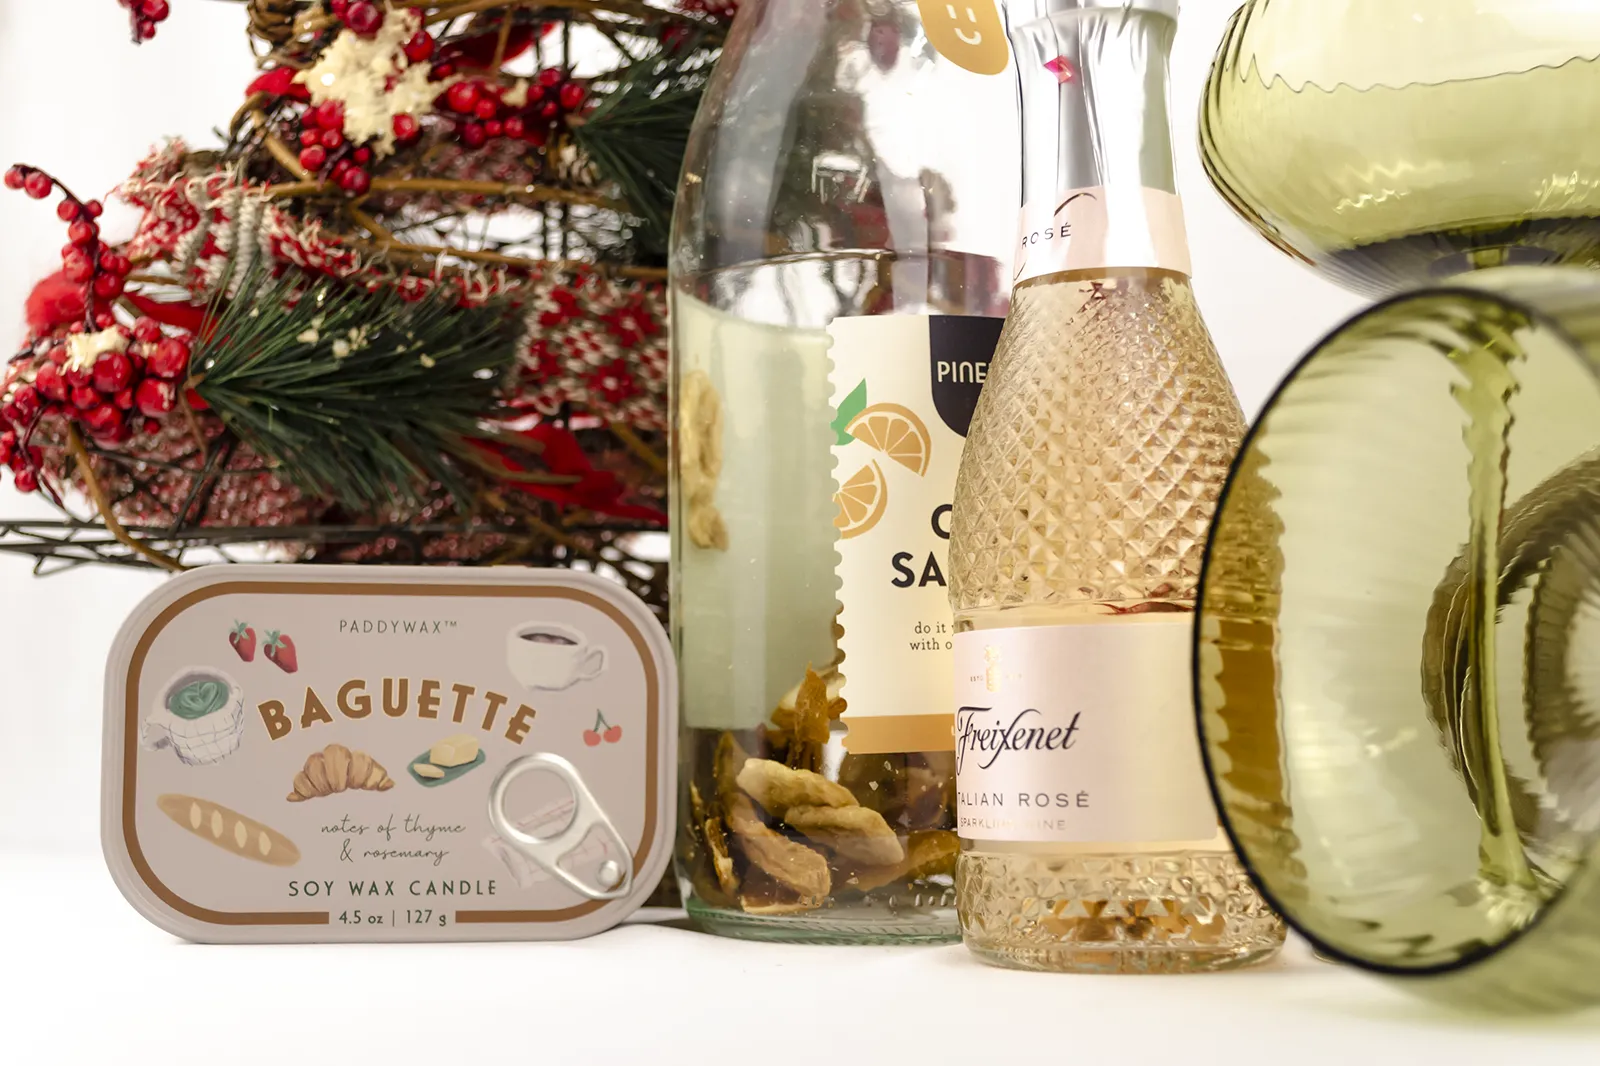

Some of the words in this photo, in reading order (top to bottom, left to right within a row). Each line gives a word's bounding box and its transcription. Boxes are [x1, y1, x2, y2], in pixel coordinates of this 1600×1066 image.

[1022, 222, 1071, 249] ROSÉ
[937, 361, 991, 383] PINE
[891, 551, 947, 588] SA
[914, 621, 931, 634] do
[936, 621, 947, 634] it
[909, 638, 940, 650] with
[945, 641, 953, 650] o
[257, 677, 537, 745] BAGUETTE
[956, 706, 1082, 776] Freixenet
[957, 792, 1004, 807] TALIAN
[1018, 789, 1089, 808] ROSÉ
[321, 813, 369, 836] notes
[377, 813, 397, 841] of
[404, 813, 466, 842] thyme
[340, 838, 354, 863] &
[363, 849, 450, 867] rosemary
[288, 880, 334, 897] SOY
[349, 880, 395, 896] WAX
[409, 880, 496, 896] CANDLE
[339, 910, 362, 925] 4.5
[367, 913, 383, 925] oz
[406, 909, 433, 924] 127
[438, 914, 447, 928] g
